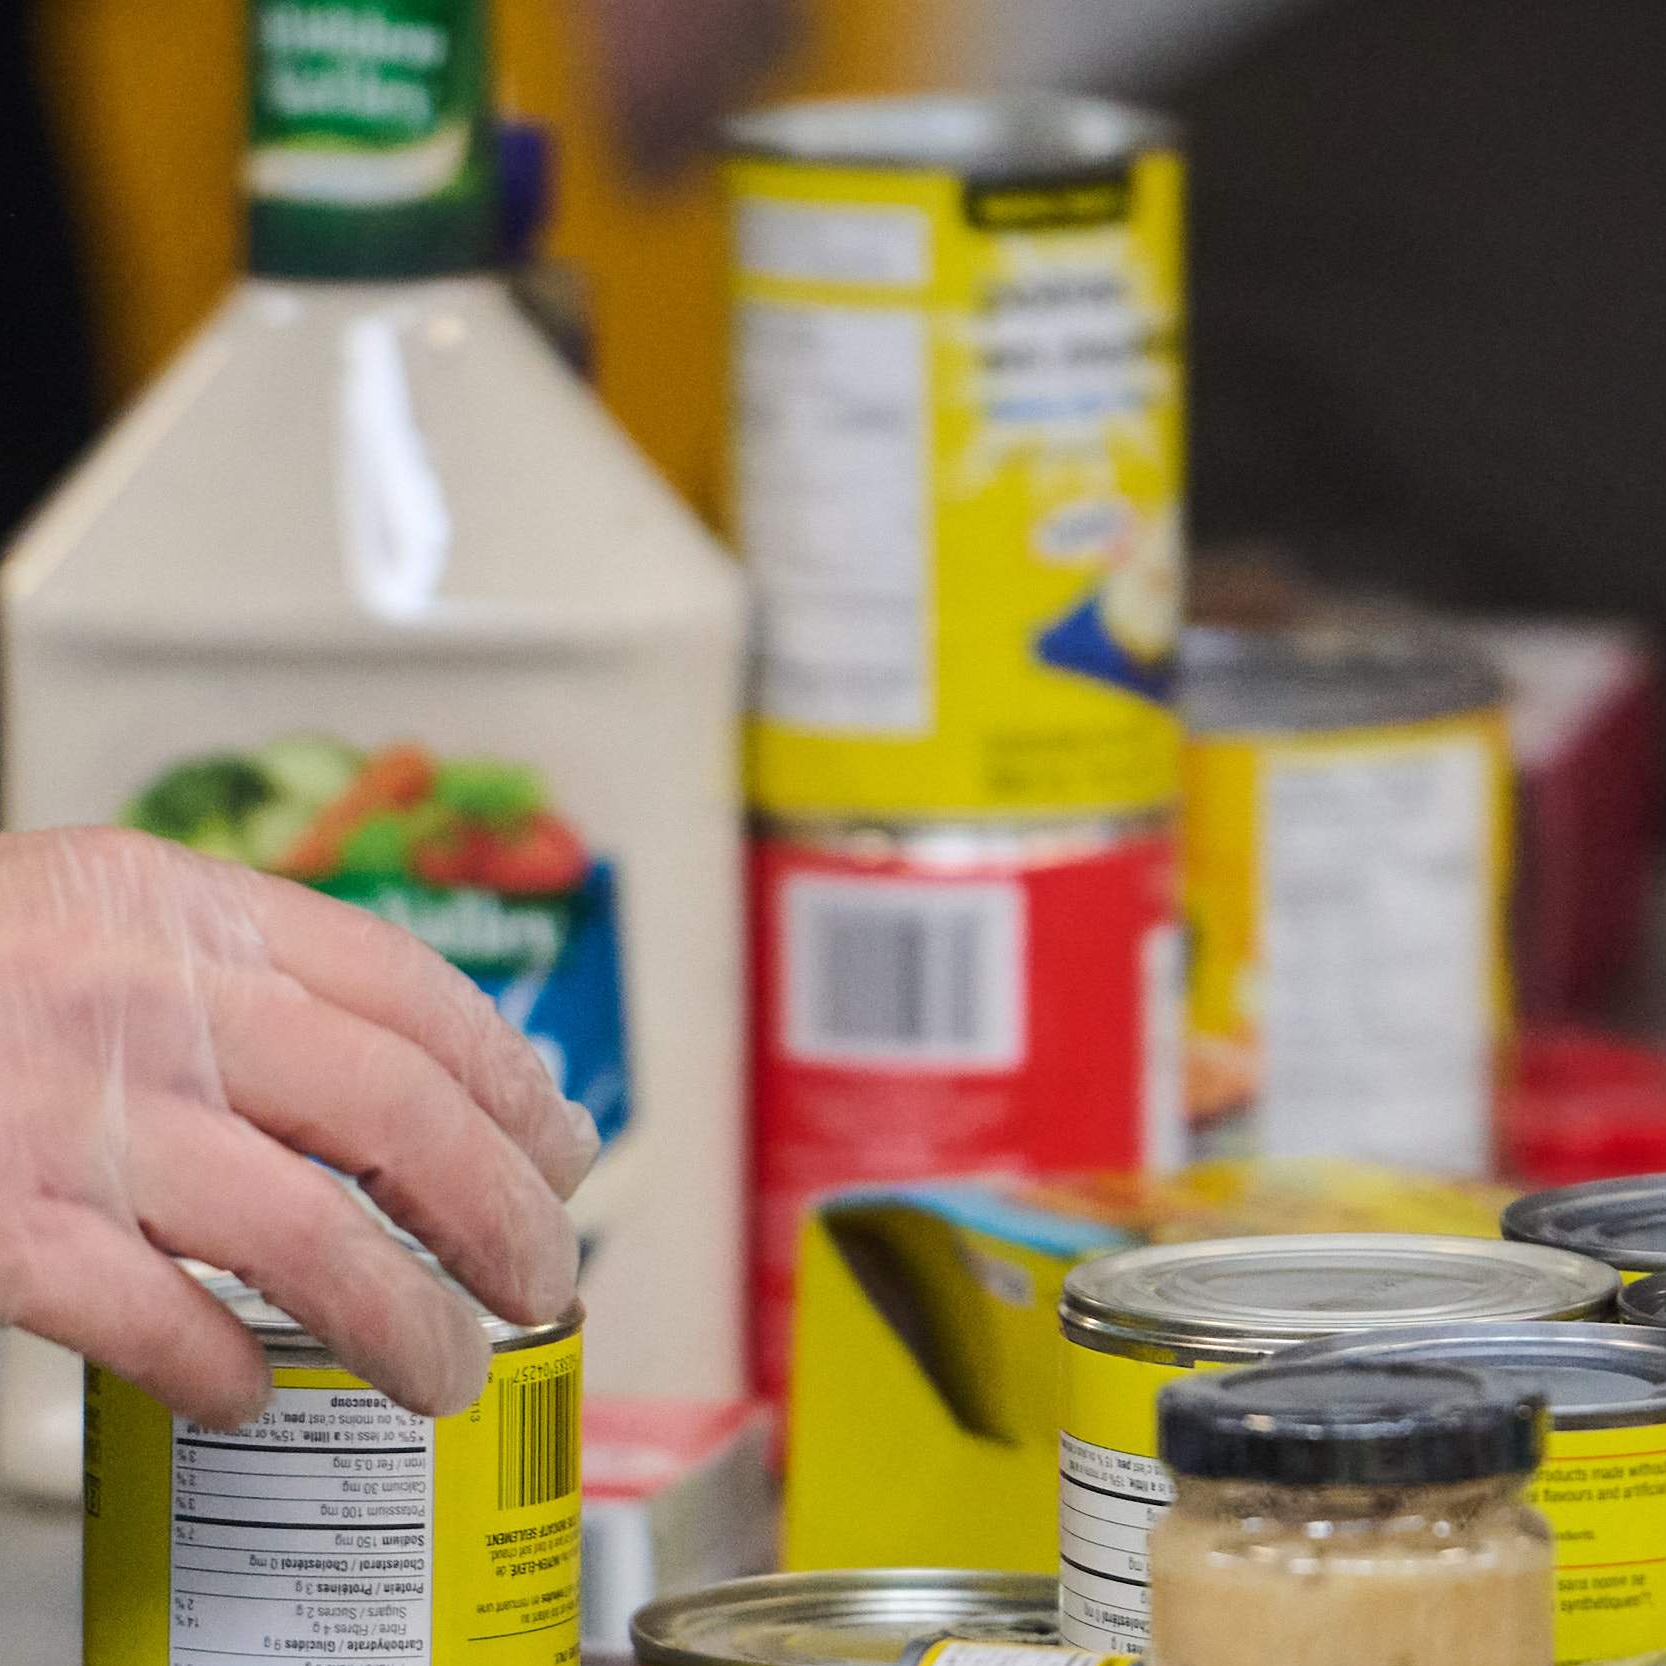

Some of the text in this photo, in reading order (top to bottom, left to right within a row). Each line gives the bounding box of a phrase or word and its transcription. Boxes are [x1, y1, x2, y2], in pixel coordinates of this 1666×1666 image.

[331, 1397, 386, 1409] beaucoup
[337, 1415, 373, 1427] moins
[378, 1414, 391, 1425] ou
[358, 1432, 379, 1443] less
[383, 1432, 394, 1441] or
[333, 1457, 425, 1470] Iron Fer 0.5 mg
[343, 1481, 360, 1492] mg
[382, 1481, 425, 1494] Calcium
[320, 1504, 425, 1518] Potassium 100 mg
[335, 1535, 424, 1547] Sodium 150 mg
[250, 1555, 267, 1566] mg
[281, 1559, 348, 1572] Cholestérol
[360, 1558, 424, 1570] Cholesterol
[317, 1583, 372, 1595] Protéines
[384, 1582, 423, 1595] Protein
[318, 1607, 356, 1619] Sucres
[368, 1605, 406, 1618] Sugars
[324, 1624, 331, 1635] 4
[335, 1624, 368, 1636] Fibres
[379, 1624, 406, 1635] Fibre
[285, 1639, 335, 1652] Glucides
[347, 1638, 423, 1651] Carbohydrate
